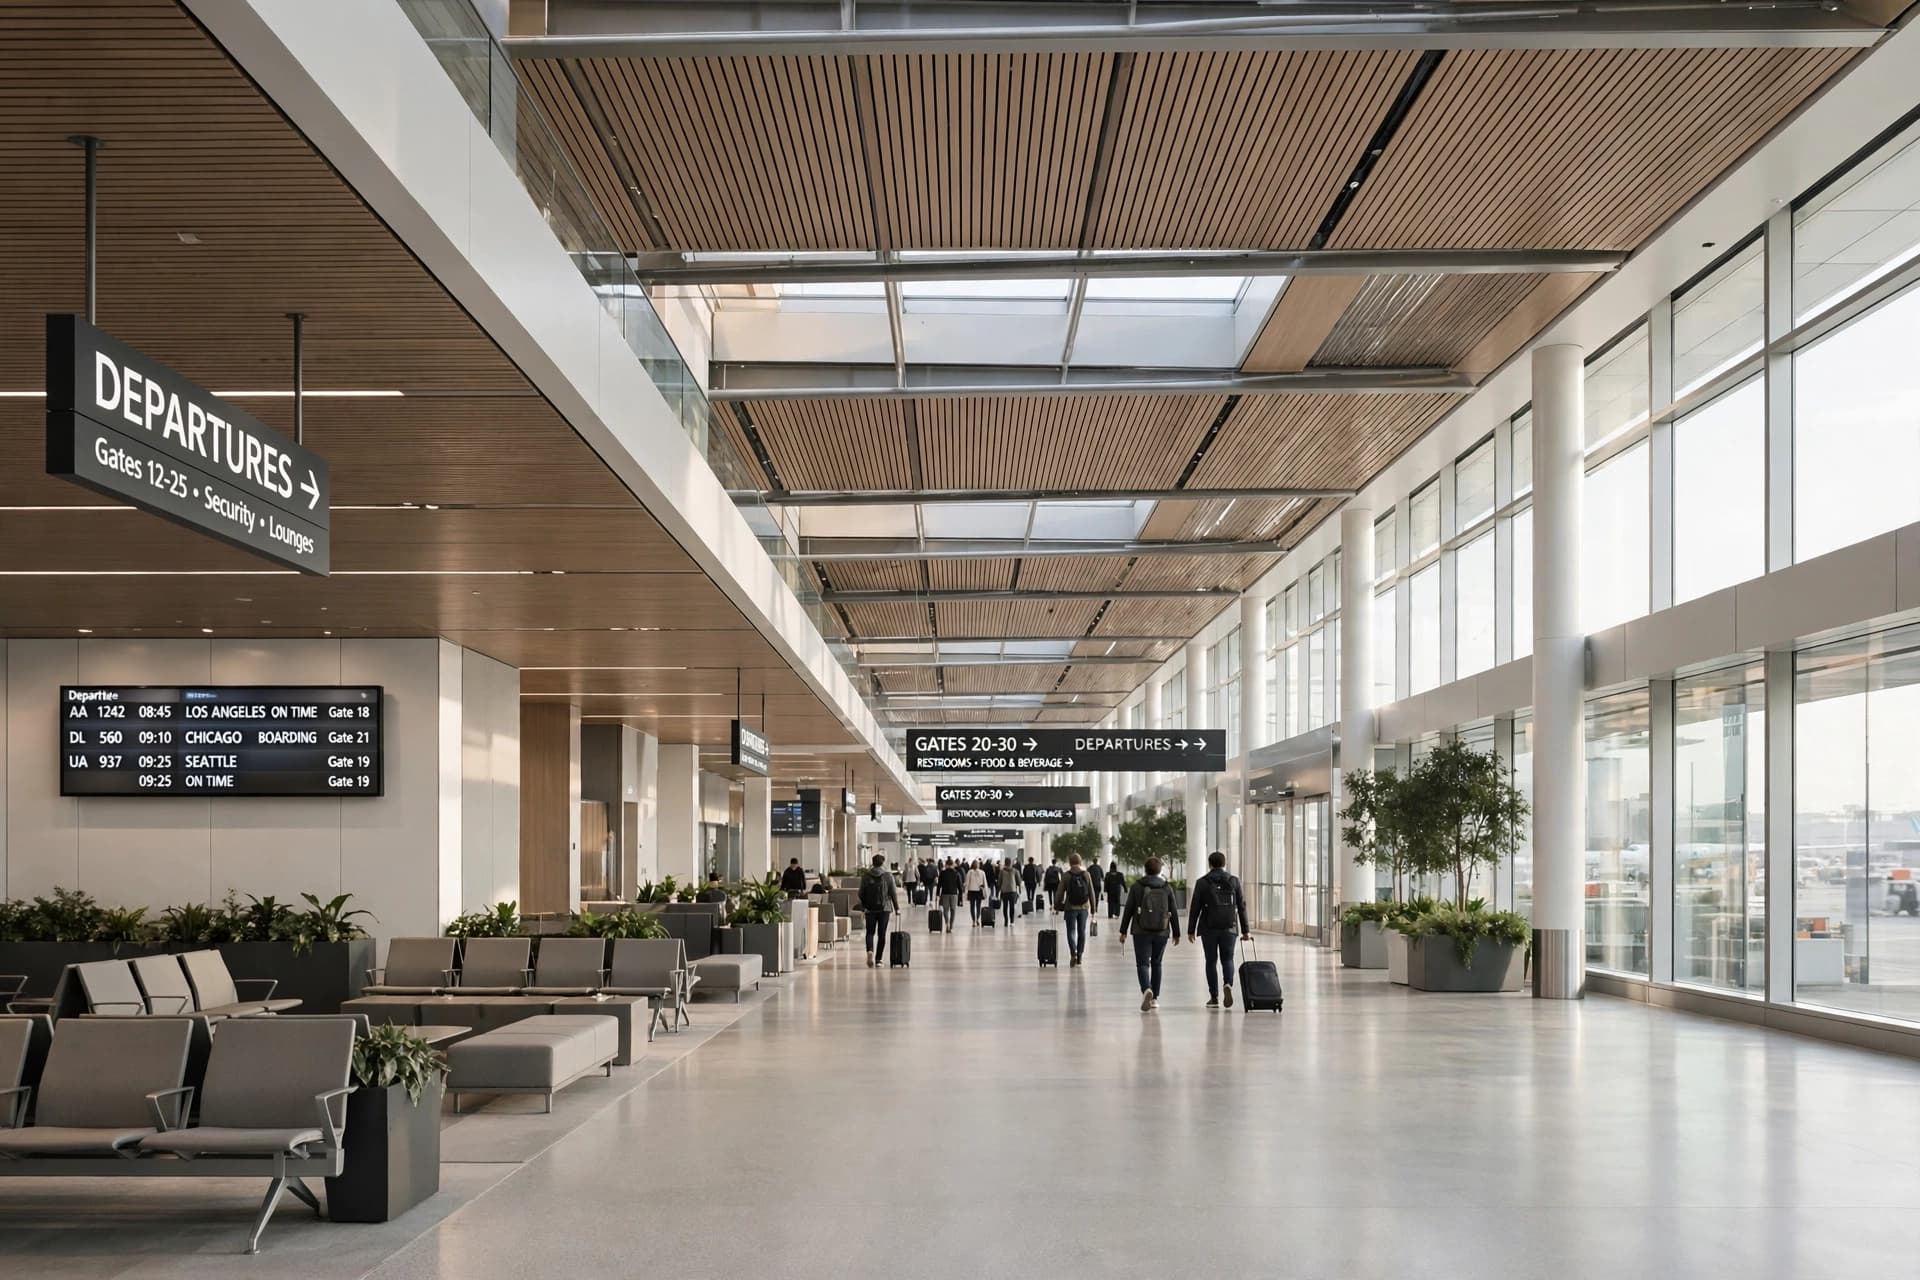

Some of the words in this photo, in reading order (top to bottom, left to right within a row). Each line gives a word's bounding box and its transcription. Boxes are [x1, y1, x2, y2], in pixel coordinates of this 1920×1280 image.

[95, 351, 293, 500] DEPARTURES
[95, 438, 142, 479] Gates
[148, 460, 187, 498] 12-25
[205, 486, 255, 533] Security
[270, 516, 313, 554] Lounges
[70, 706, 88, 718] AA
[98, 706, 125, 717] 1242
[139, 706, 171, 718] 08:45
[186, 706, 208, 718] LOS
[211, 706, 265, 718] ANGELES
[271, 706, 287, 718] ON
[291, 706, 317, 718] TIME
[329, 707, 353, 717] Gate
[358, 707, 369, 717] 18
[70, 731, 86, 743] DL
[100, 731, 122, 743] 560
[139, 731, 171, 743] 09:10
[186, 731, 242, 743] CHICAGO
[259, 731, 316, 743] BOARDING
[328, 732, 353, 743] Gate
[357, 732, 368, 743] 21
[916, 737, 966, 751] GATES
[972, 737, 1016, 751] 20-30
[1076, 738, 1171, 750] DEPARTURES
[70, 756, 88, 768] UA
[99, 755, 122, 768] 937
[139, 756, 171, 768] 09:25
[186, 755, 237, 767] SEATTLE
[328, 756, 353, 767] Gate
[358, 756, 370, 767] 19
[917, 758, 971, 767] RESTROOMS
[981, 758, 1006, 767] FOOD
[1009, 758, 1015, 767] &
[139, 775, 171, 787] 09:25
[186, 776, 202, 786] ON
[206, 775, 233, 786] TIME
[328, 776, 353, 787] Gate
[357, 776, 369, 787] 19
[941, 790, 971, 800] GATES
[974, 790, 1002, 799] 20-30
